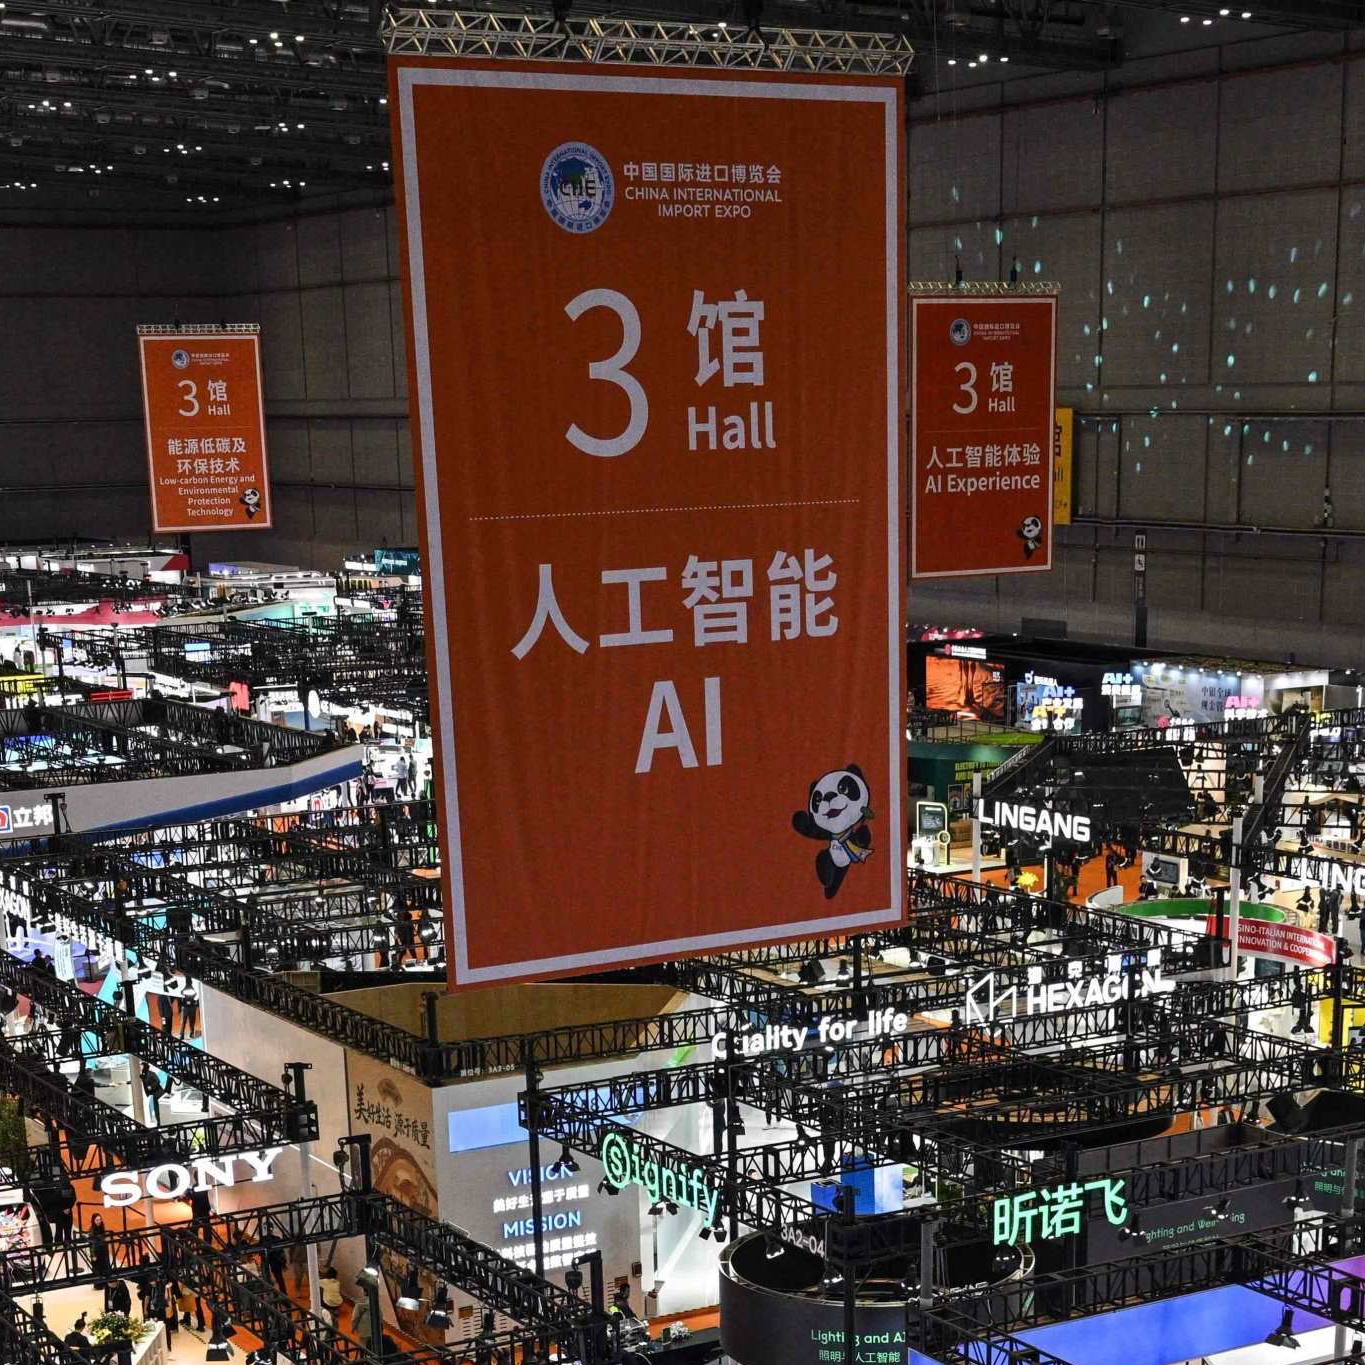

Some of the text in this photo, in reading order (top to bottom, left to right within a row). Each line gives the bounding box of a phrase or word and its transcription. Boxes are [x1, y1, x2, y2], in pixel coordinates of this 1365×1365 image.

[623, 161, 782, 185] 中国国际进口博览会
[624, 186, 782, 203] CHINA INTERNATIONAL
[658, 203, 751, 218] IMPORT EXPO
[564, 288, 765, 457] 3 馆
[177, 380, 228, 417] 3 馆
[952, 361, 1014, 414] 3 馆
[208, 405, 231, 416] Hall
[988, 398, 1016, 413] Hall
[688, 401, 776, 450] Hall
[167, 437, 247, 456] 能源低碳及
[925, 444, 1041, 470] 人工智能体验
[176, 458, 240, 475] 环保技术
[159, 474, 255, 486] Low-carbon Energy and
[178, 486, 239, 495] Environmental
[925, 472, 1041, 496] AI Experience
[187, 507, 234, 517] Technology
[188, 497, 231, 505] Protection
[510, 549, 839, 661] 人工智能
[635, 677, 722, 773] AI
[12, 804, 54, 828] 立邦
[977, 798, 1091, 843] LINGANG
[711, 1007, 908, 1060] Quality for life
[488, 1063, 516, 1074] 3A2-05
[100, 1147, 285, 1209] SONY
[601, 1131, 721, 1227] Signify
[992, 1178, 1129, 1247] 昕诺飞
[780, 1223, 826, 1258] 3A2-04
[811, 1329, 889, 1346] Lightig and
[819, 1349, 901, 1364] 照明人工智能
